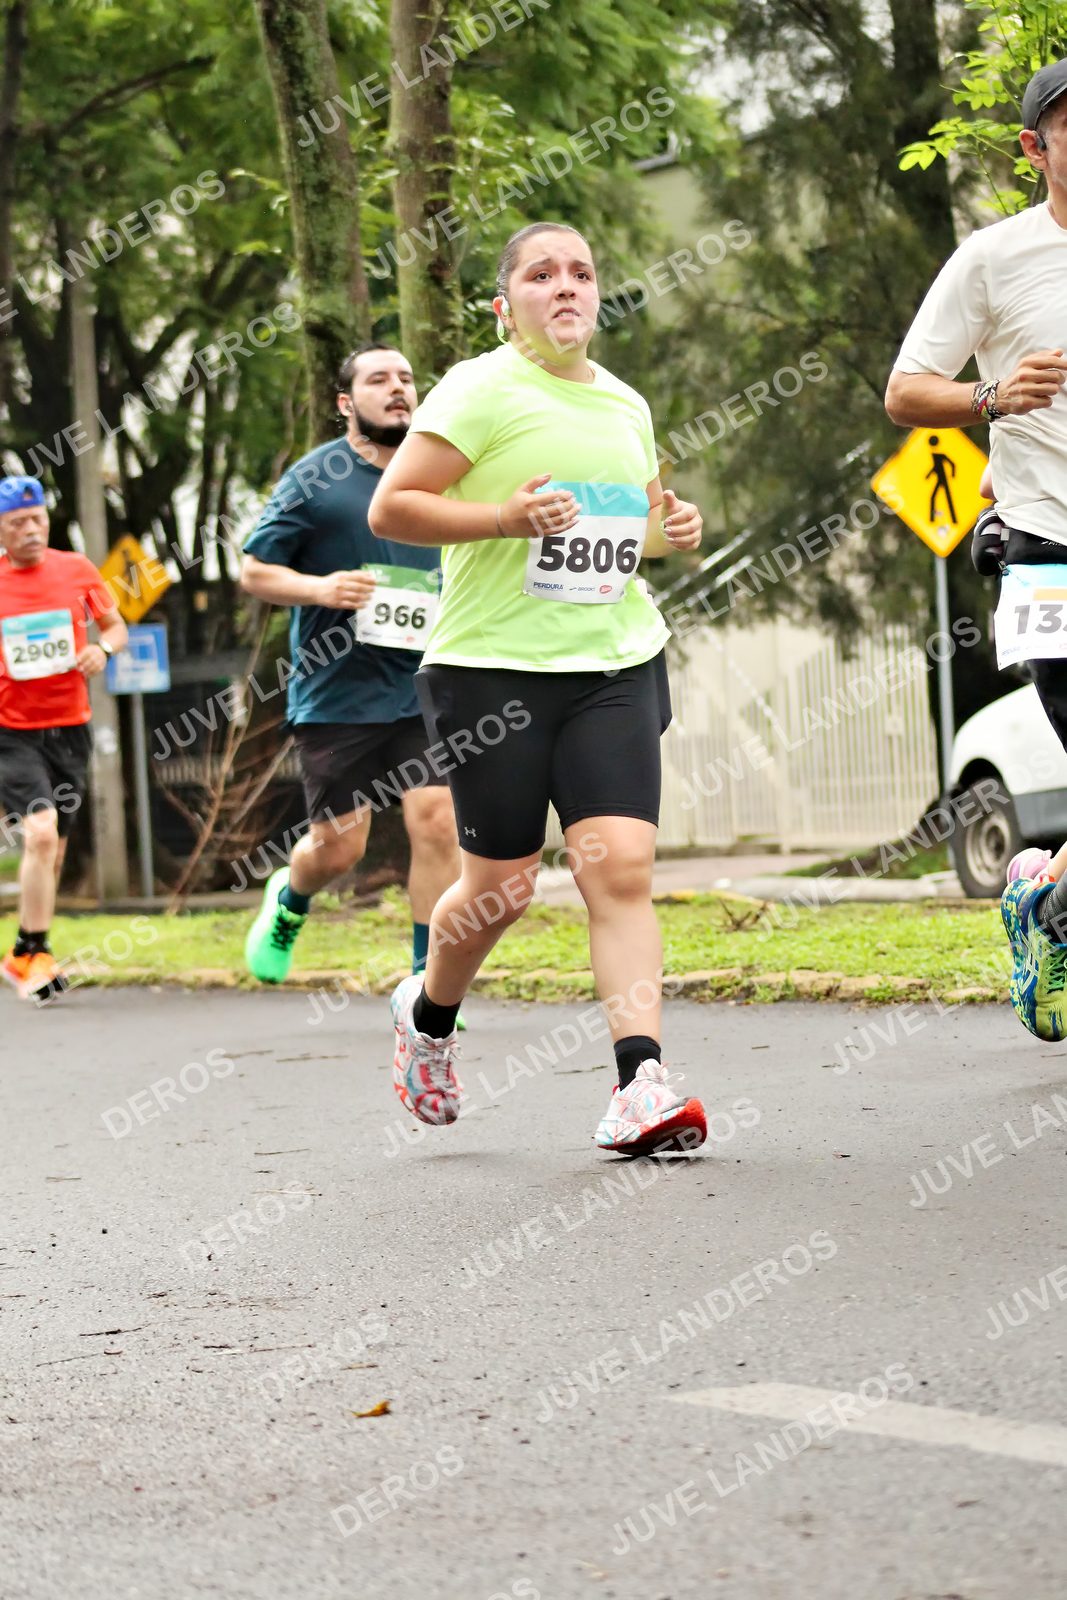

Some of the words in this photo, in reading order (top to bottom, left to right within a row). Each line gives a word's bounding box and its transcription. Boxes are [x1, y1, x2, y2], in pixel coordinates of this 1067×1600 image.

[536, 537, 639, 574] 5806
[533, 582, 564, 590] PERDURA
[374, 603, 427, 629] 966
[1014, 604, 1067, 635] 13
[12, 639, 69, 664] 2909
